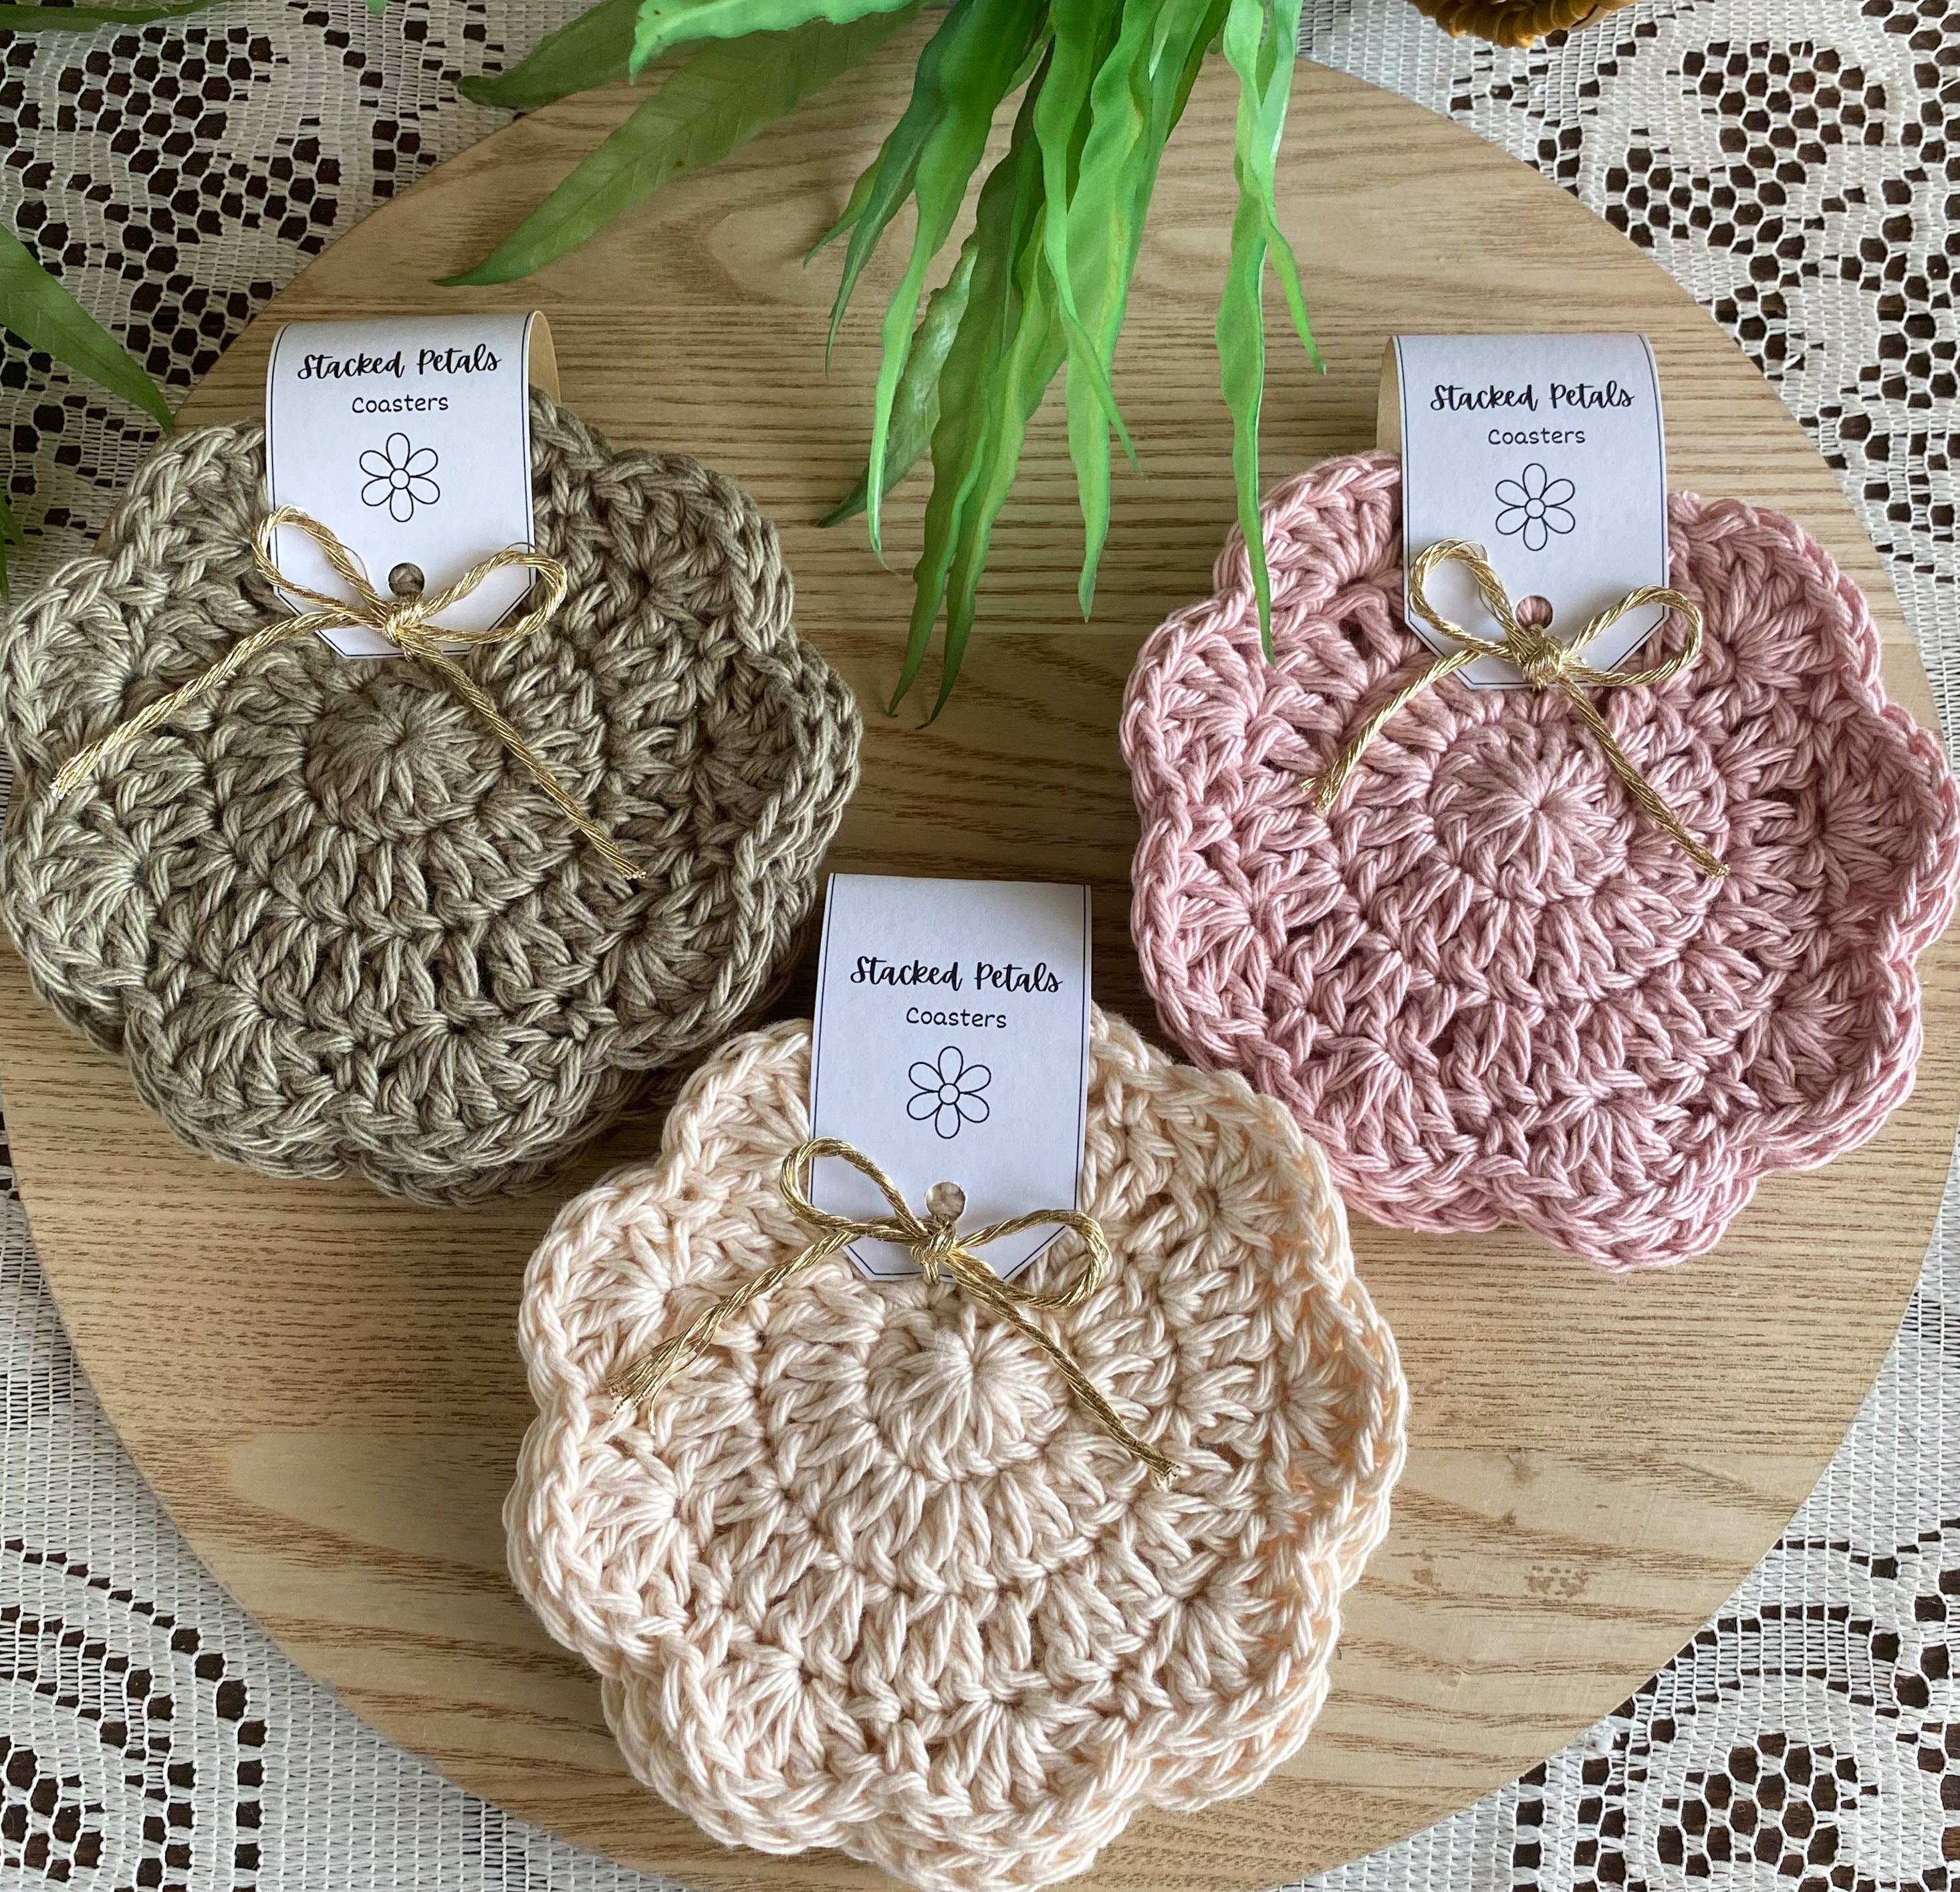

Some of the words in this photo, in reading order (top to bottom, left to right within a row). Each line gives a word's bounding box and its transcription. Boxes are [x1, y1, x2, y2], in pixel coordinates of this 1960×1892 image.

[297, 351, 406, 380] Stacked
[416, 343, 502, 375] Petals
[352, 394, 449, 414] Coasters
[1430, 384, 1539, 412] Stacked
[1550, 380, 1636, 409] Petals
[1488, 427, 1586, 445] Coasters
[850, 956, 963, 992] Stacked
[973, 962, 1064, 993] Petals
[906, 1006, 1007, 1029] Coasters
